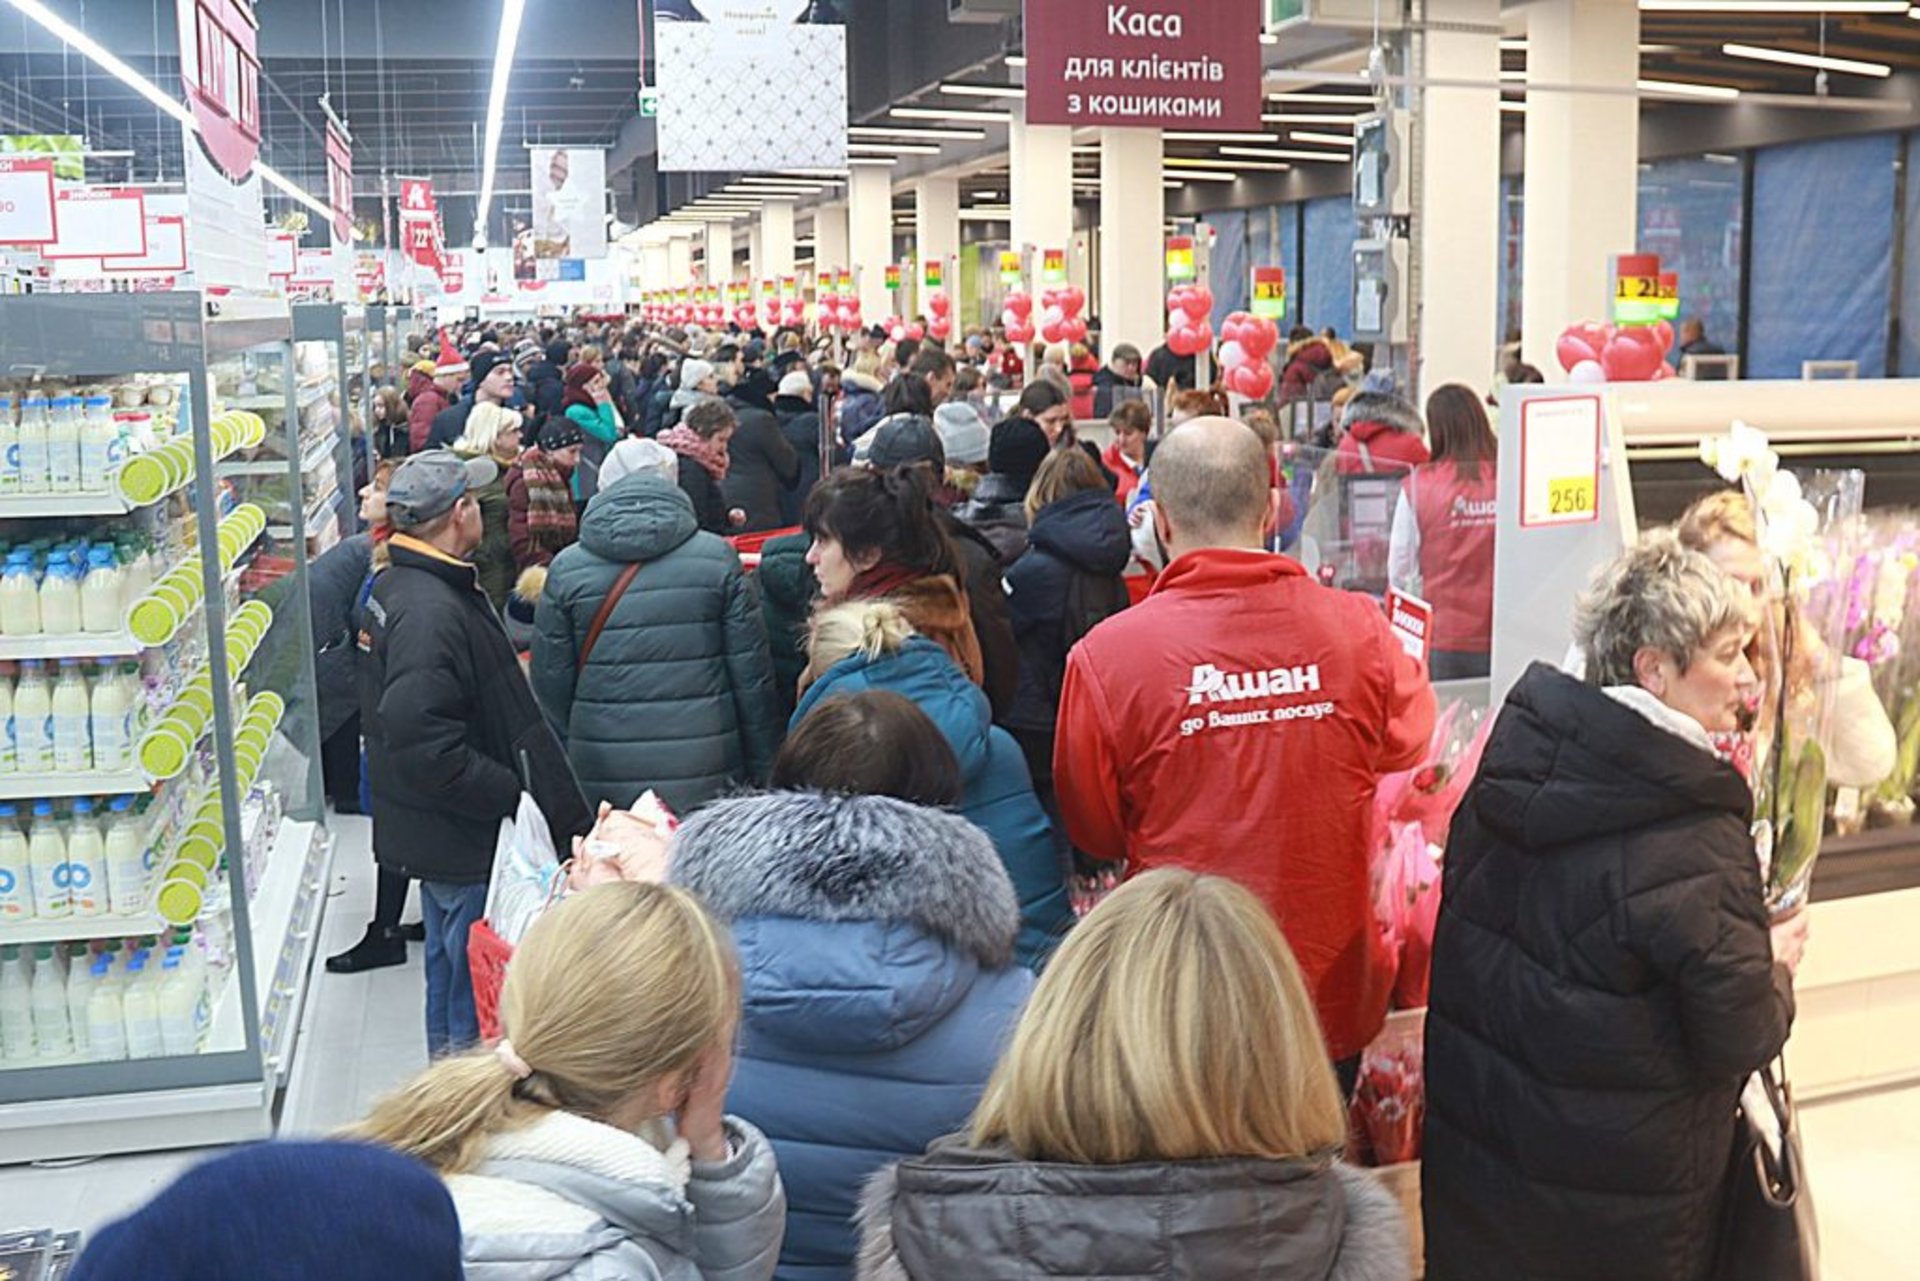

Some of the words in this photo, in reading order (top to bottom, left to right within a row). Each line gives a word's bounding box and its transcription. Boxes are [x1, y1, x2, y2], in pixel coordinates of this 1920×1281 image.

[1107, 4, 1182, 37] Каса
[1064, 57, 1114, 81] для
[1121, 54, 1224, 81] клієнтів
[1067, 95, 1081, 114] з
[1089, 95, 1221, 117] кошиками
[1551, 487, 1586, 514] 256
[1185, 663, 1321, 706] Ашан
